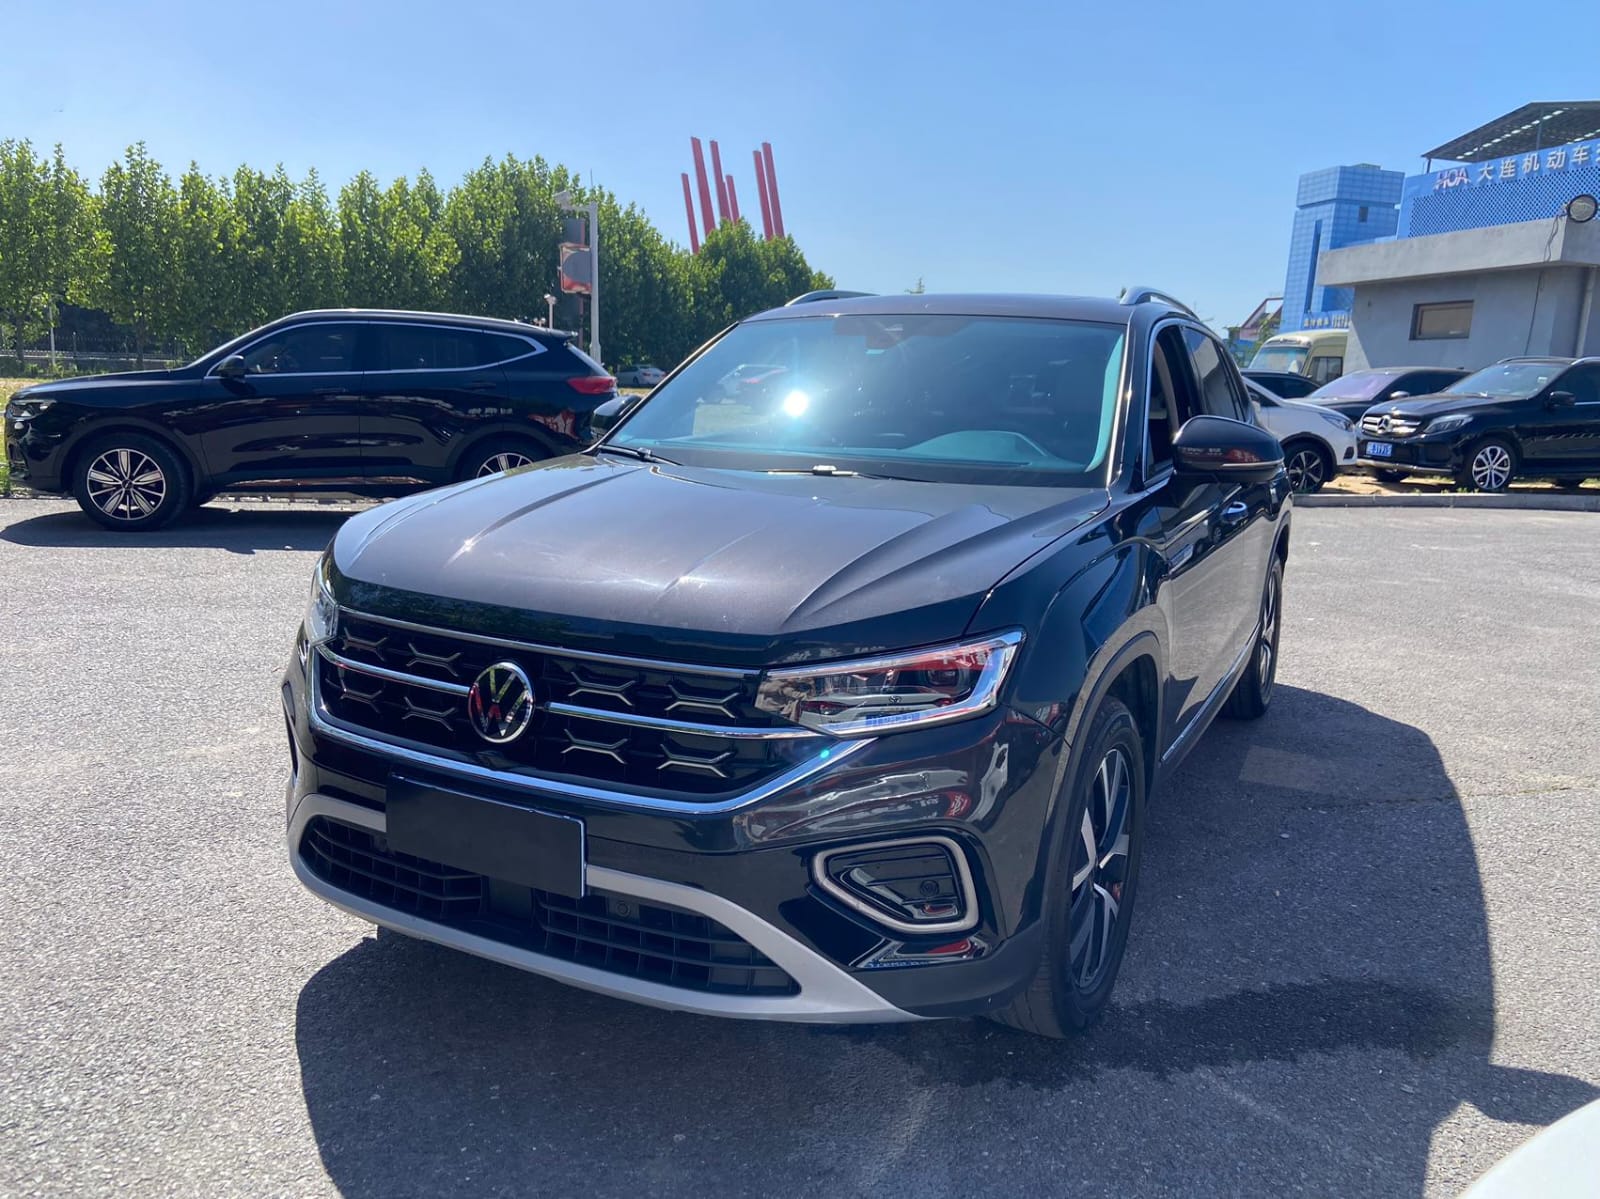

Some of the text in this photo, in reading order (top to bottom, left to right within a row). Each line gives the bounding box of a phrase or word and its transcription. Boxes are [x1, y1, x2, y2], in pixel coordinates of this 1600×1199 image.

[1476, 142, 1600, 183] 大连机动车
